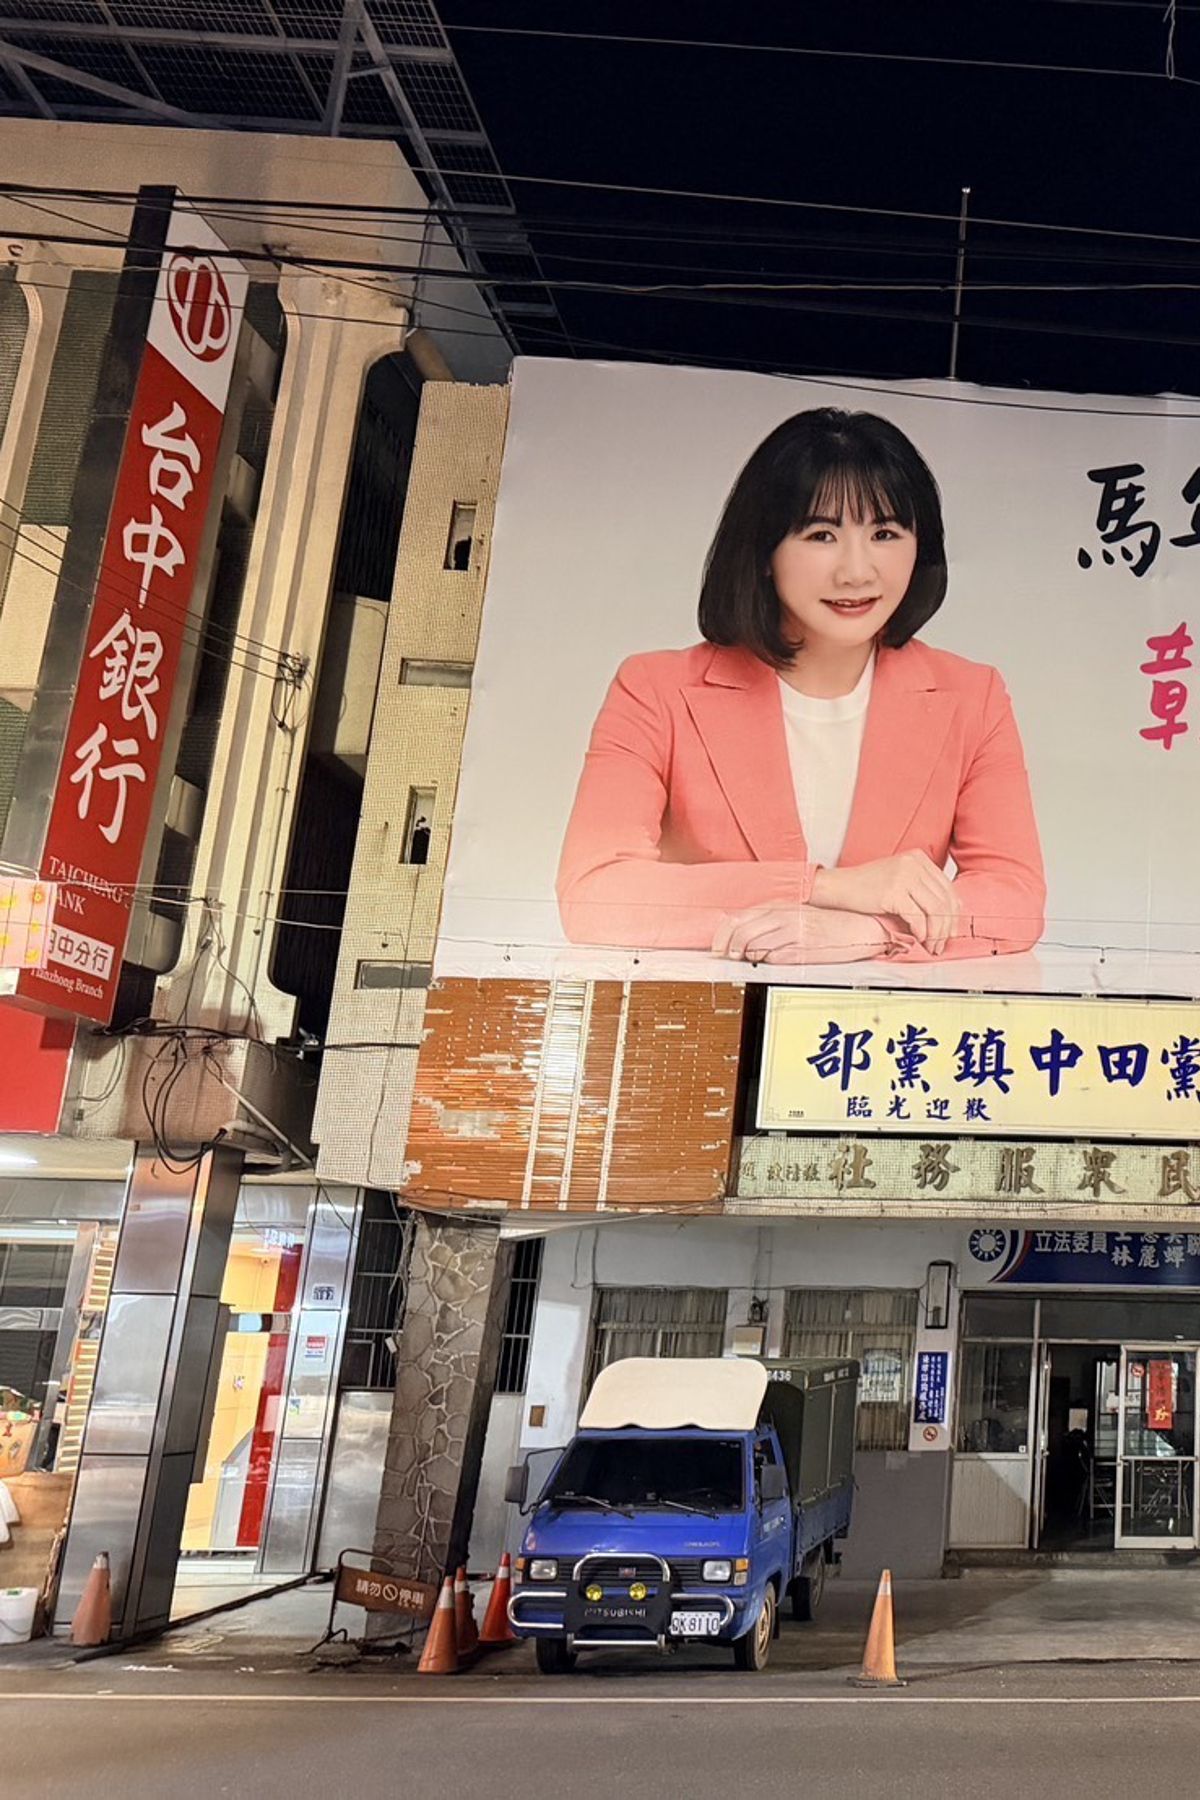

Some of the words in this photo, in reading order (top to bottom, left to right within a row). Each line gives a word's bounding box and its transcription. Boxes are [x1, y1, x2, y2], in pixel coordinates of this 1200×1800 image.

[69, 400, 202, 845] 台中銀行
[49, 855, 124, 903] TAICHUNG
[56, 888, 87, 916] ANK
[75, 977, 104, 999] Branch
[1034, 1231, 1108, 1254] 立法委員
[1111, 1246, 1186, 1269] 林麗蟬
[355, 1578, 381, 1598] 請勿
